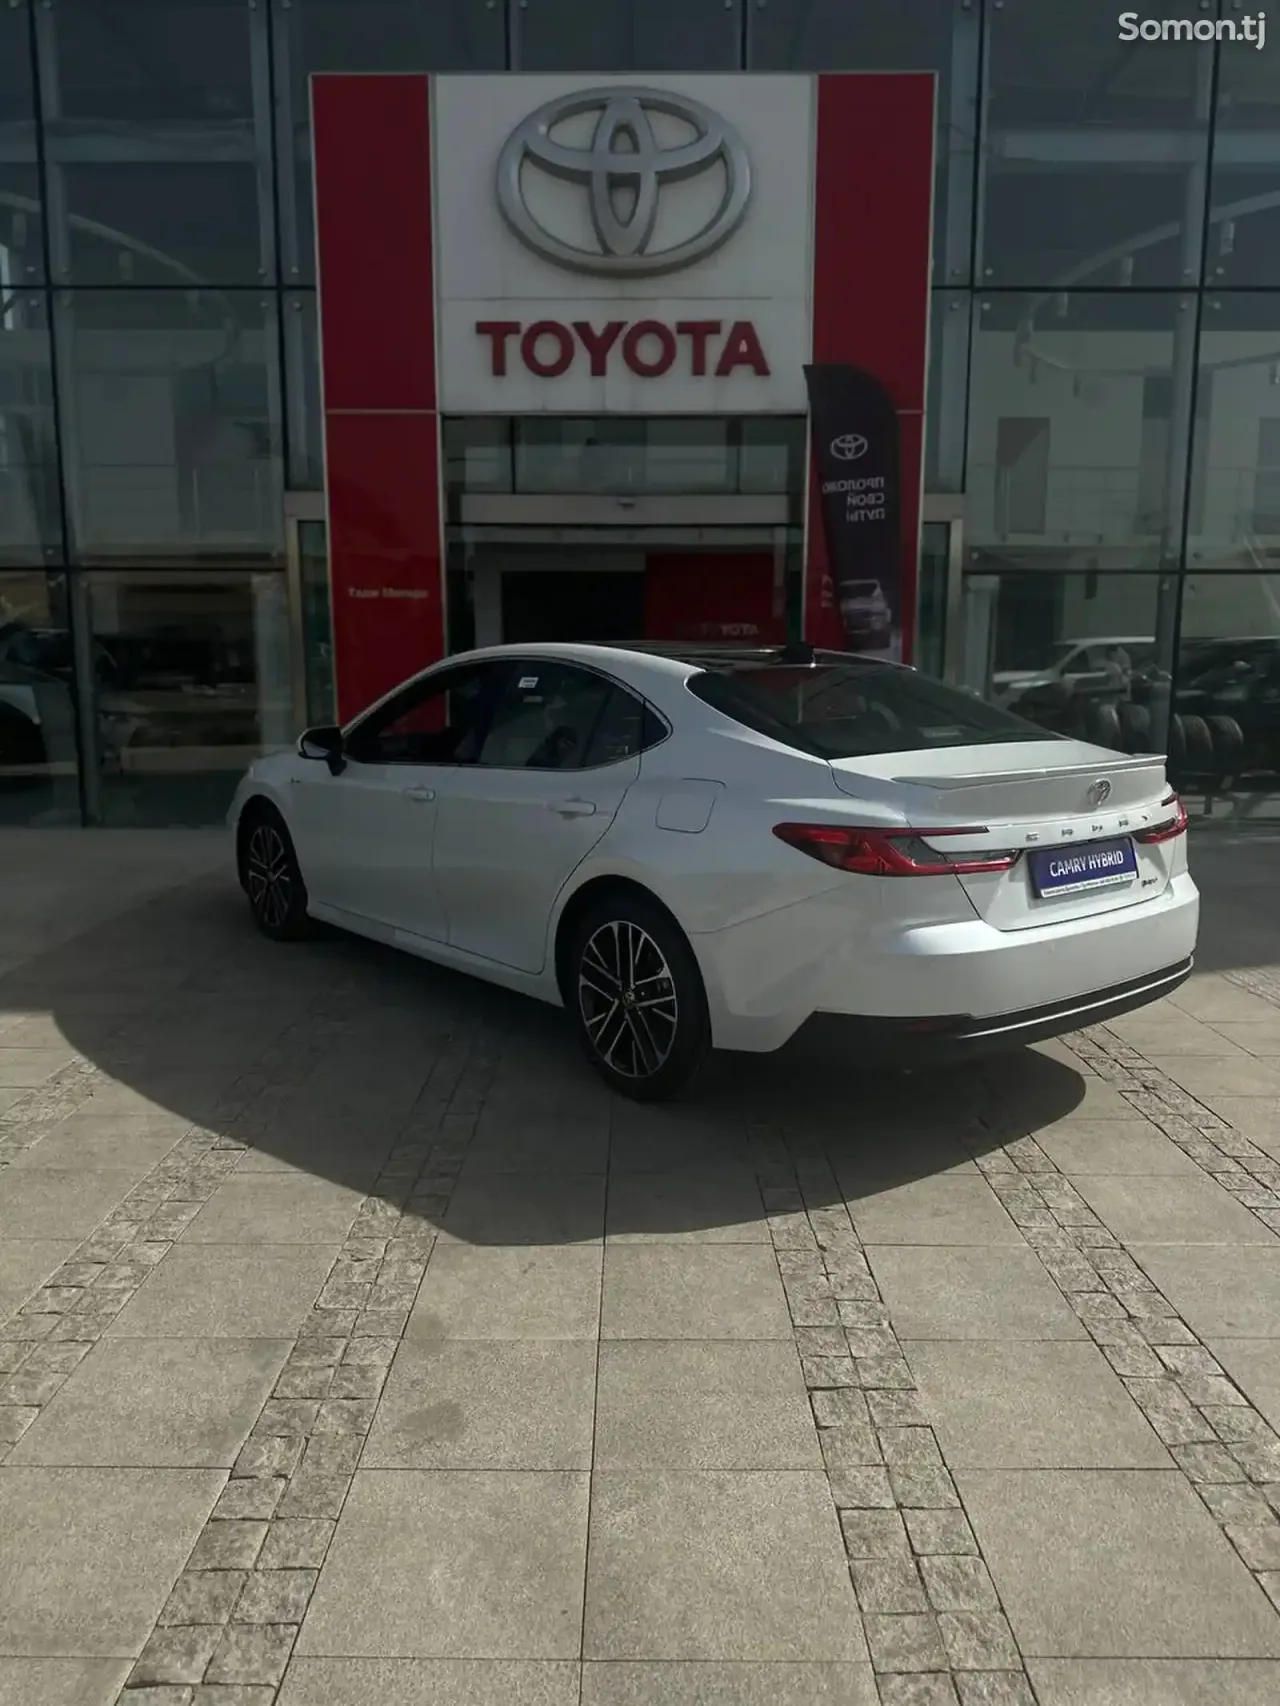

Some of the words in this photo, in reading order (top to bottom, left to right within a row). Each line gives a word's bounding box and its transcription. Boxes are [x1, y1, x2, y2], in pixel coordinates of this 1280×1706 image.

[475, 320, 771, 377] TOYOTA
[701, 622, 759, 636] TYOTA
[1050, 856, 1087, 877] CAMRY
[1087, 850, 1124, 869] HYBRID
